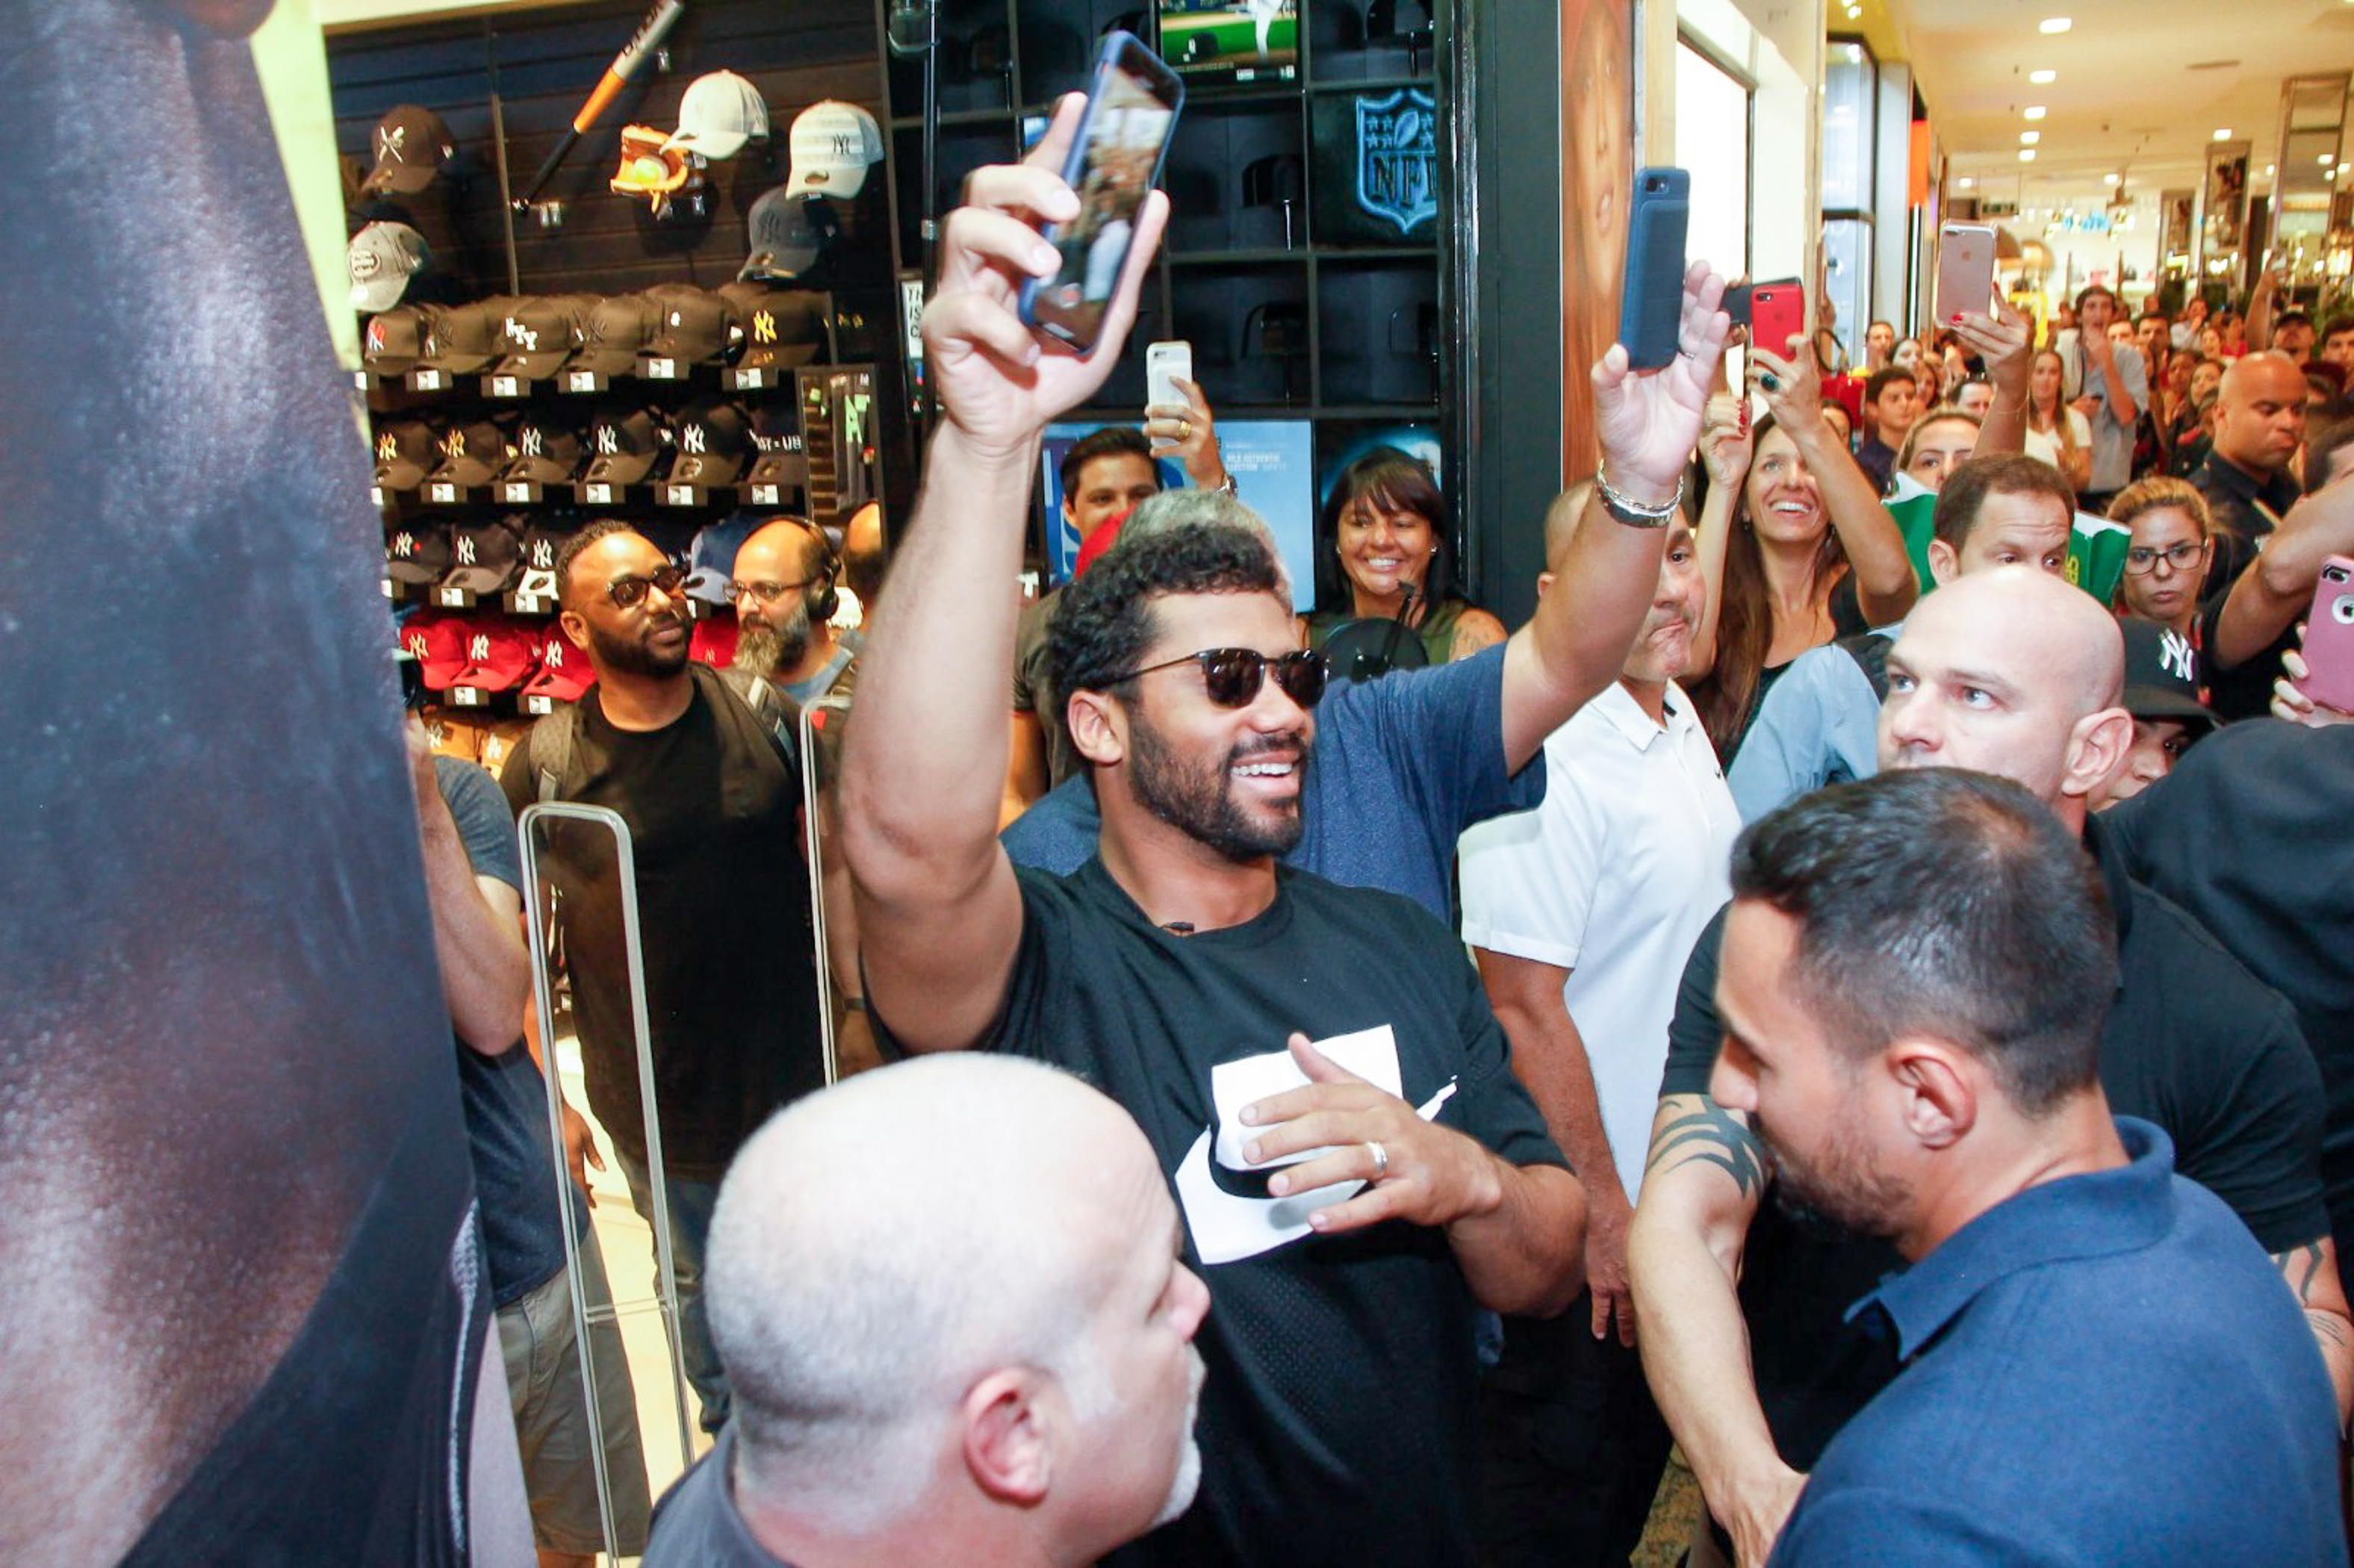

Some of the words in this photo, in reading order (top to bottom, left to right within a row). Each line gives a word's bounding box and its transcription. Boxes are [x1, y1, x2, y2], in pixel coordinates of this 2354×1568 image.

[754, 309, 777, 343] NY
[379, 432, 398, 461] NY
[447, 428, 465, 458] NY
[522, 426, 542, 457] NY
[598, 424, 618, 455] NY
[683, 423, 706, 454] NY
[395, 532, 413, 557] NY
[457, 535, 476, 565] NY
[533, 538, 553, 568] NY
[409, 633, 429, 660] NY
[471, 634, 490, 661] NY
[544, 640, 563, 668] NY
[2159, 628, 2194, 682] NY
